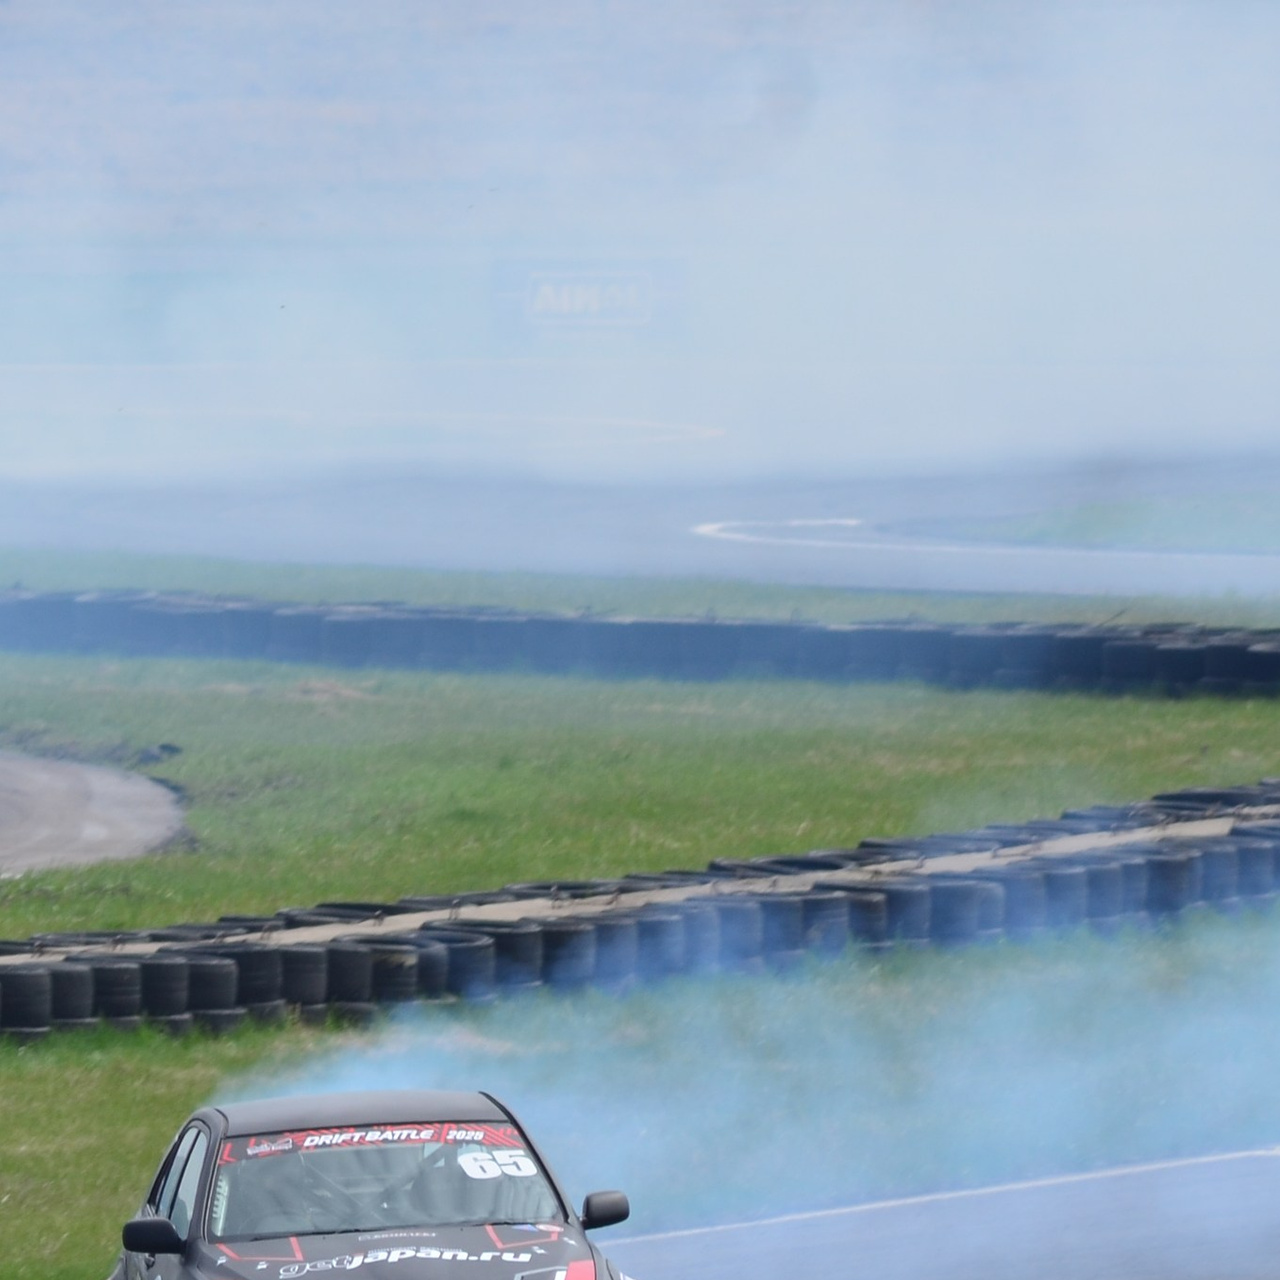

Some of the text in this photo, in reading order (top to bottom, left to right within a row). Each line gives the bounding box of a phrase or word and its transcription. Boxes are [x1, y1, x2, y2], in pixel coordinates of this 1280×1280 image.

[303, 1131, 365, 1147] DRIFT
[365, 1129, 434, 1141] BATTLE
[457, 1149, 538, 1180] 65
[279, 1247, 532, 1280] getjapan.ru
